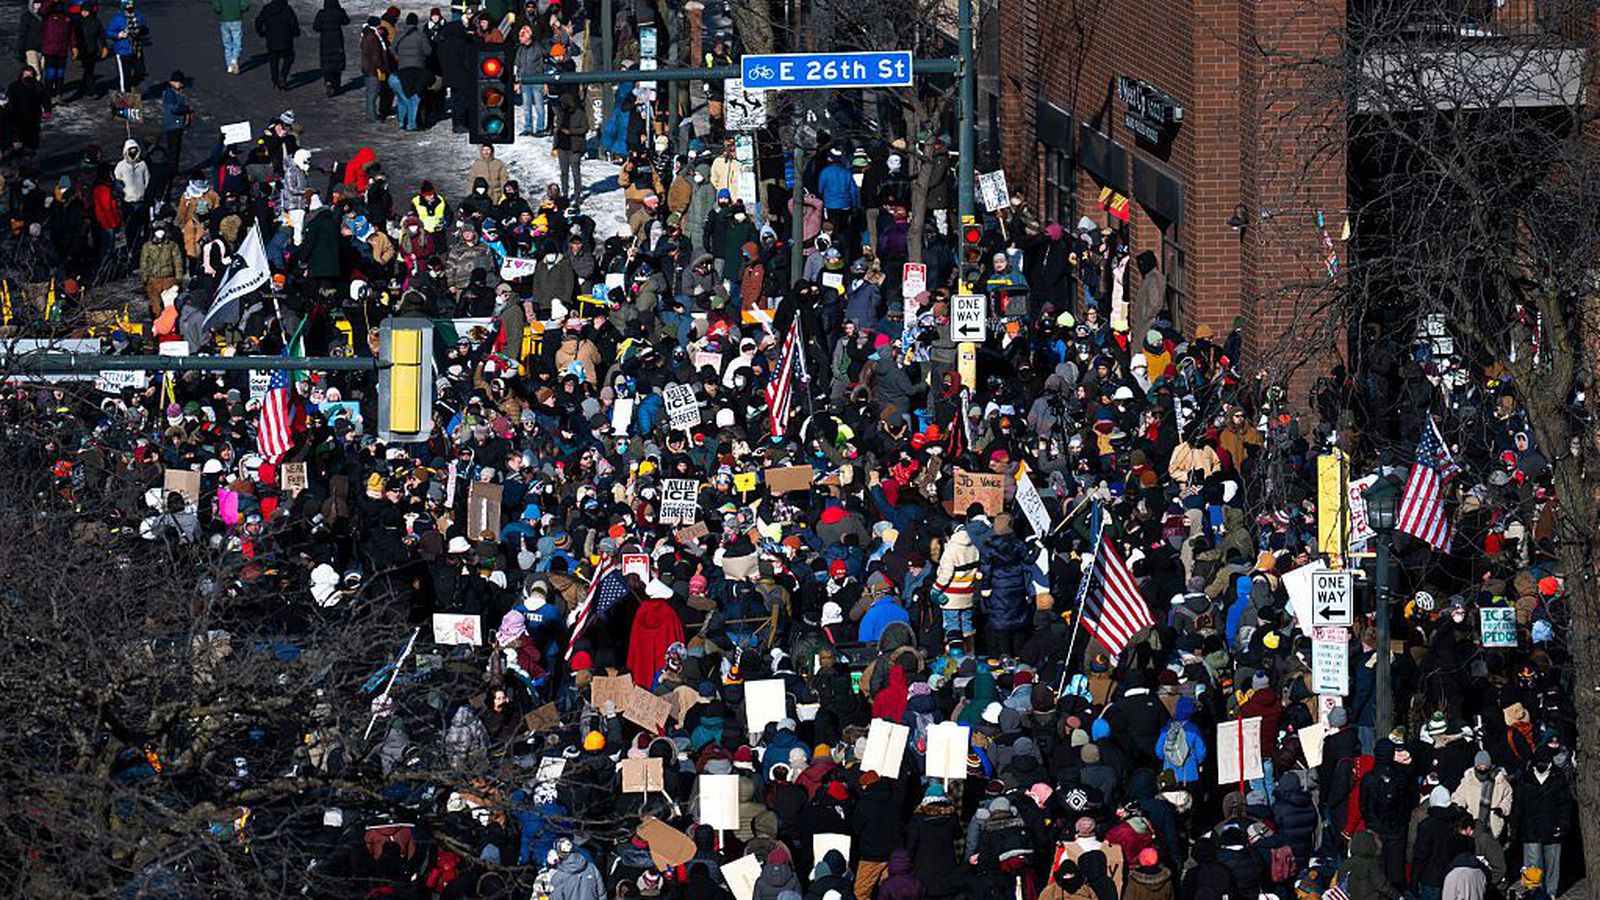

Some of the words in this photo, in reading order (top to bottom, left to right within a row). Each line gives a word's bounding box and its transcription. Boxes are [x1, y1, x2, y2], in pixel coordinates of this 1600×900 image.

[779, 62, 796, 81] E
[806, 60, 867, 81] 26th
[877, 58, 905, 79] St
[958, 298, 980, 310] ONE
[957, 311, 981, 322] WAY
[667, 393, 696, 411] ICE
[958, 474, 974, 488] JD
[664, 490, 696, 501] ICE
[661, 507, 694, 518] STREETS
[1318, 576, 1345, 589] ONE
[1317, 591, 1346, 603] WAY
[1483, 609, 1513, 621] ICE
